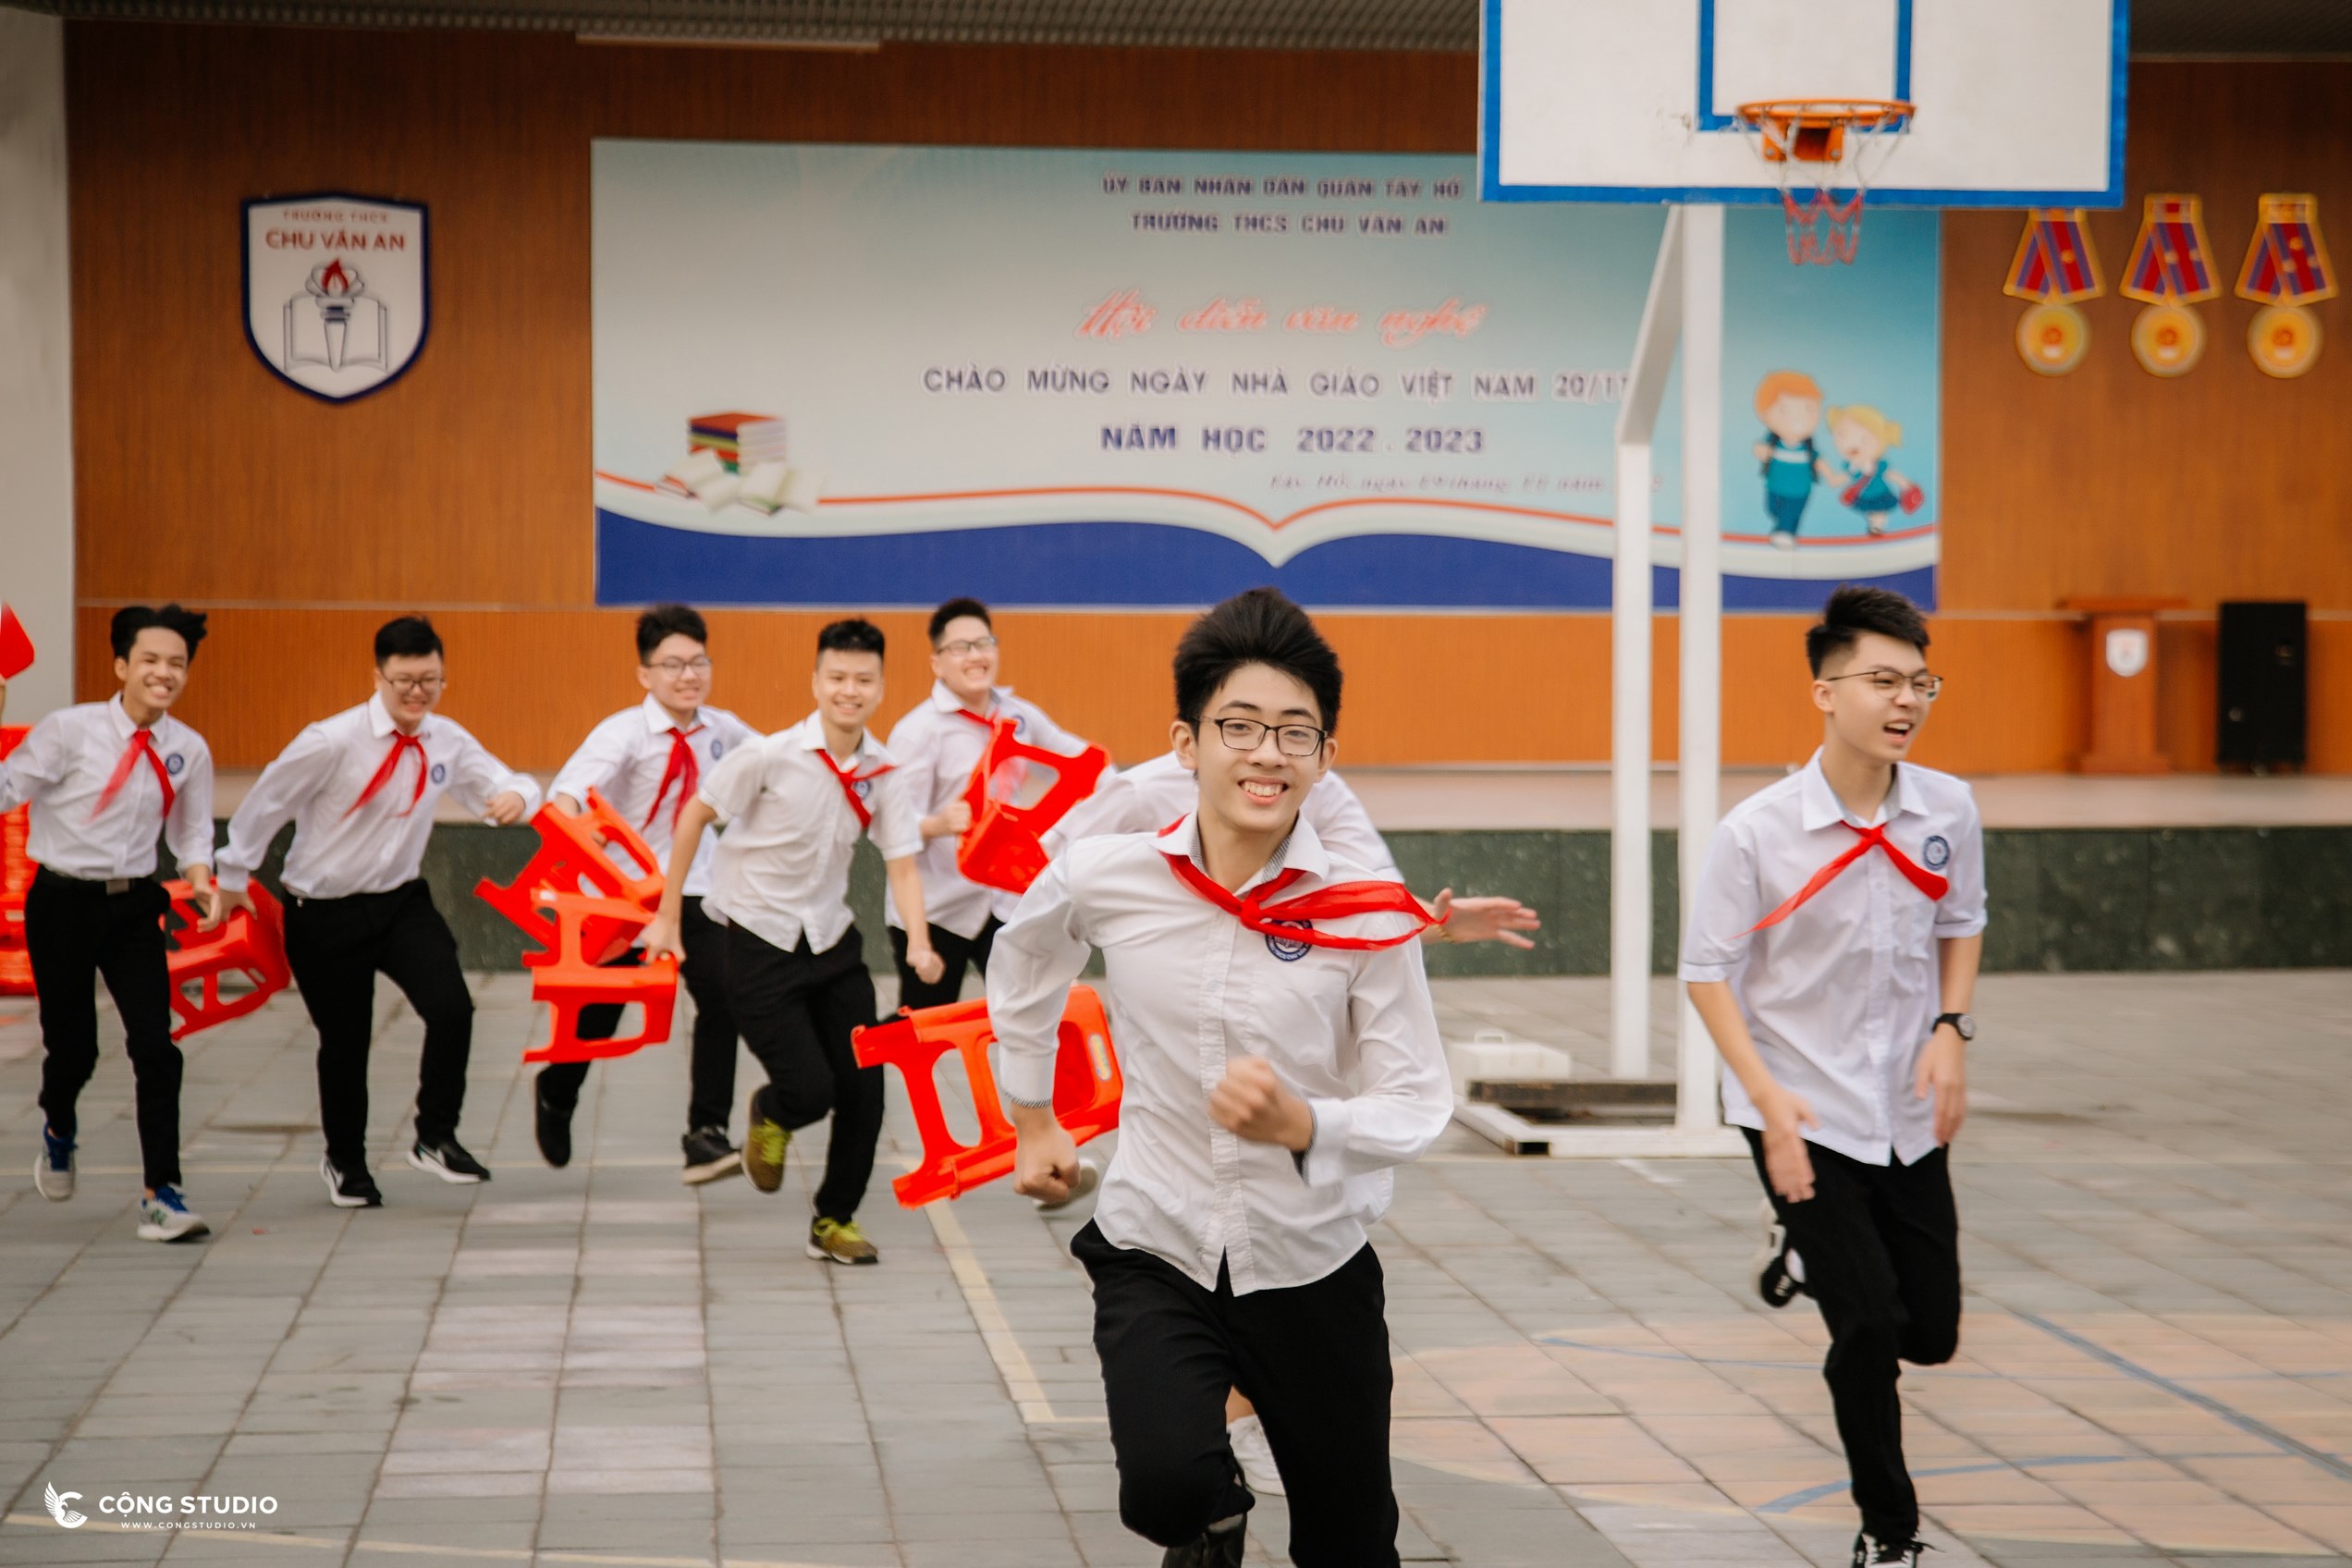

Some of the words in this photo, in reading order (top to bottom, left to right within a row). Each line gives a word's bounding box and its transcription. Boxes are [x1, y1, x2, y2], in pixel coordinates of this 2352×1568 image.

[264, 230, 314, 250] CHU
[320, 229, 367, 251] VĂN
[373, 232, 405, 251] AN
[1232, 214, 1289, 234] THCS
[1301, 215, 1345, 235] CHU
[1415, 216, 1445, 237] AN
[924, 364, 1006, 393] CHÀO
[1027, 364, 1109, 393] MỪNG
[1131, 366, 1207, 394] NGÀY
[1231, 368, 1288, 396] NHÀ
[1309, 367, 1379, 398] GIÁO
[1401, 368, 1453, 405] VIỆT
[1474, 375, 1535, 397] NAM
[1100, 423, 1177, 450] NĂM
[1202, 428, 1266, 458] HỌC
[1297, 428, 1375, 453] 2022
[1406, 429, 1484, 454] 2023
